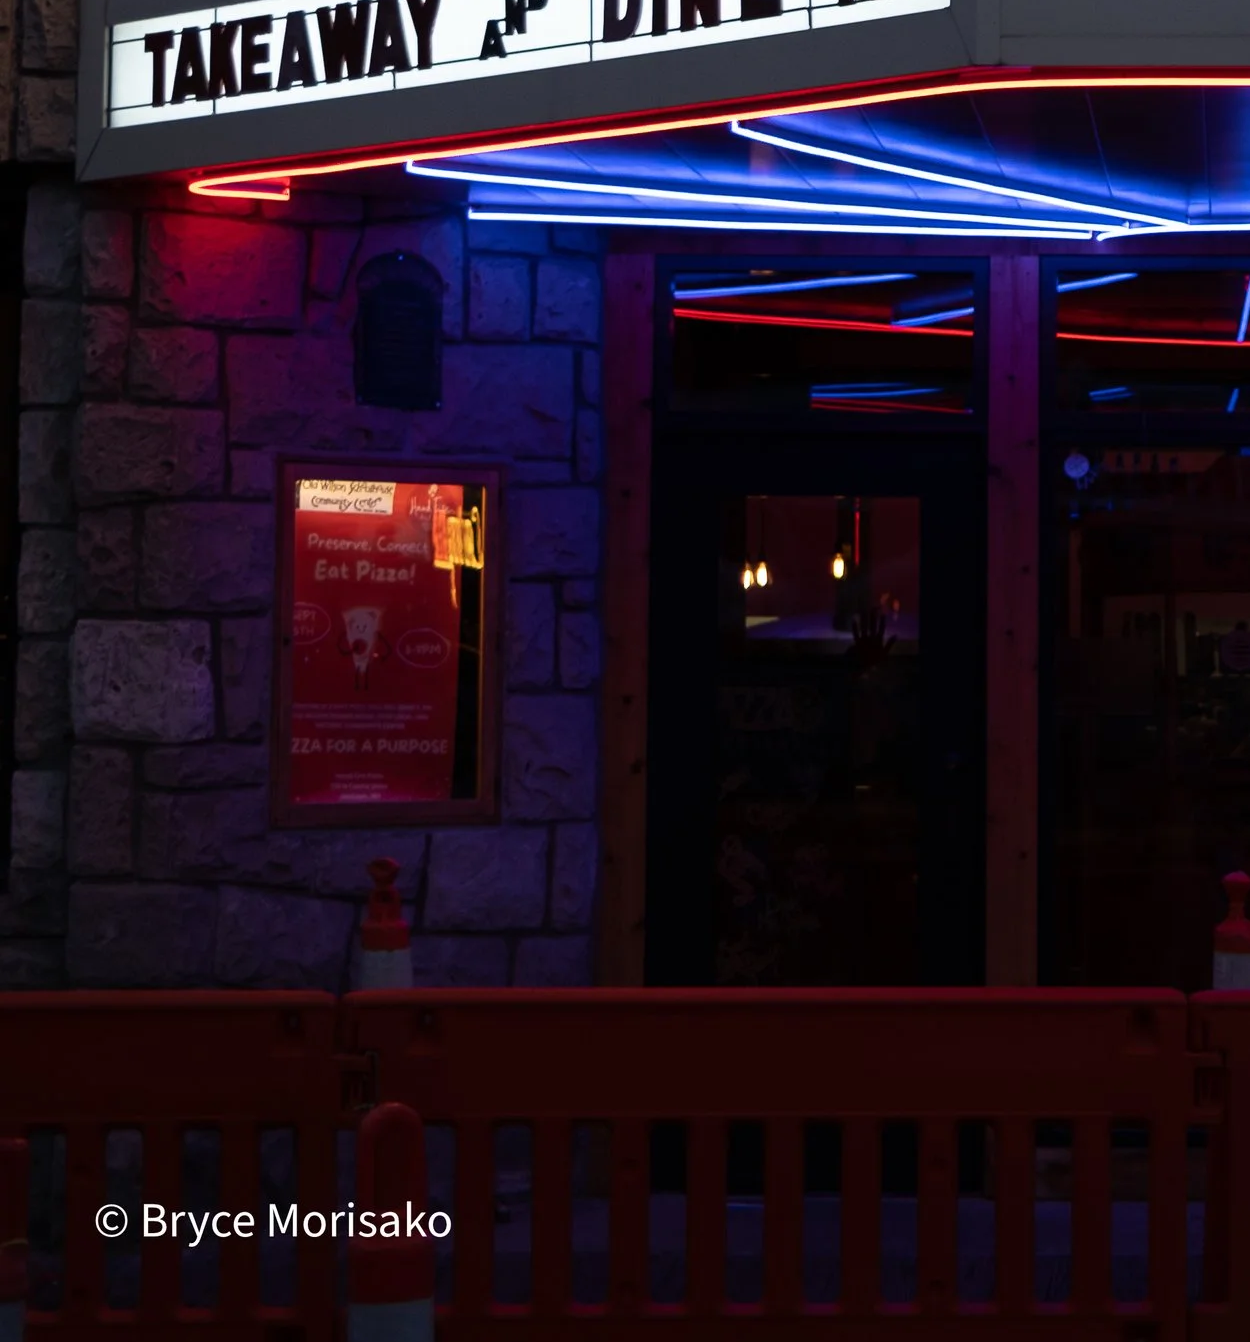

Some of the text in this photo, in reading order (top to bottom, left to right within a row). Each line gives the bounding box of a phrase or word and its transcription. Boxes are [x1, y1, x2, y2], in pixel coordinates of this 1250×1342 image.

[307, 532, 372, 554] Preserve,
[314, 559, 416, 586] Eat Pizza!
[326, 738, 357, 754] FOR
[361, 739, 374, 753] A
[377, 738, 449, 755] PURPOSE
